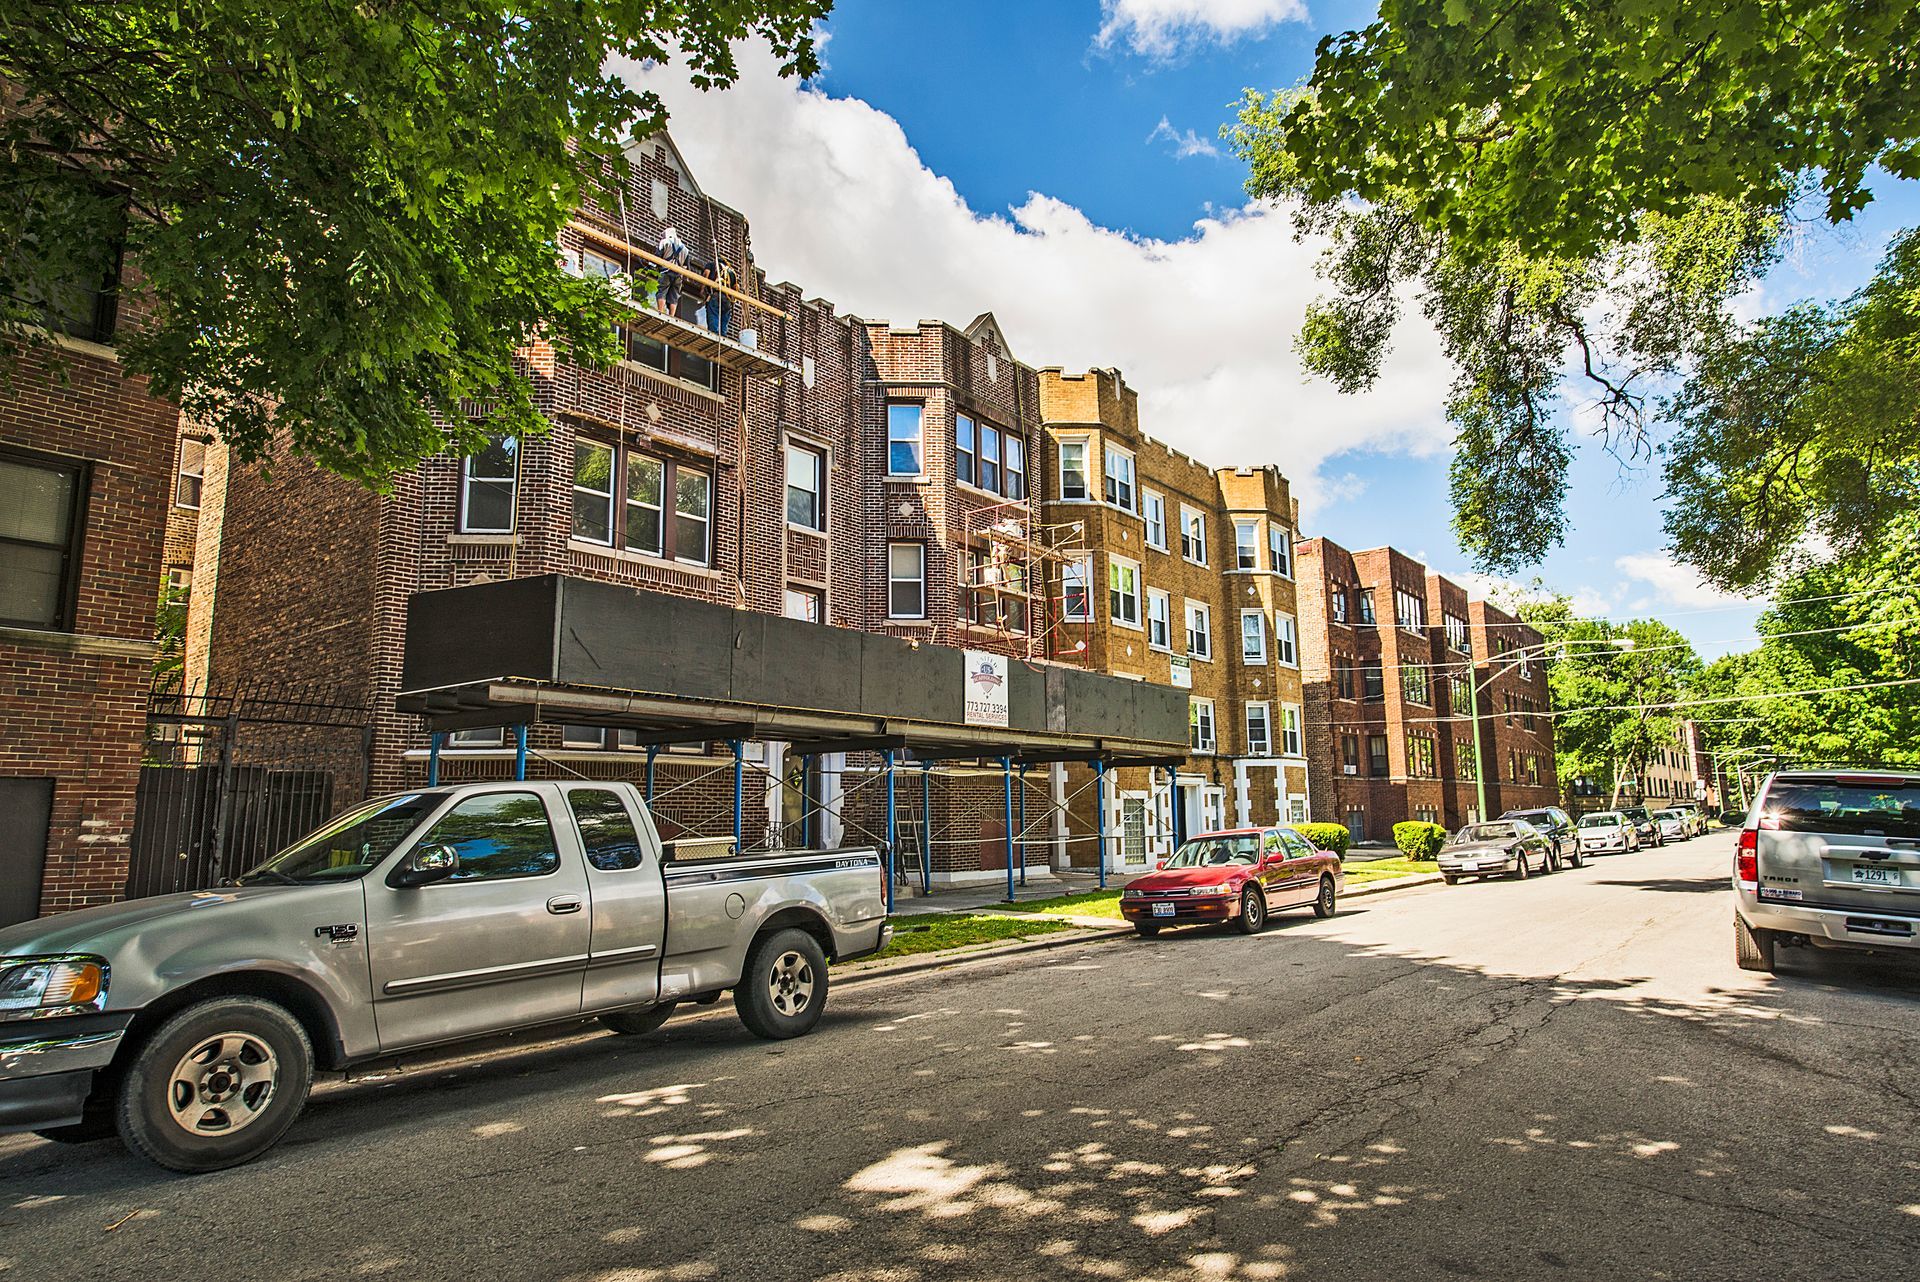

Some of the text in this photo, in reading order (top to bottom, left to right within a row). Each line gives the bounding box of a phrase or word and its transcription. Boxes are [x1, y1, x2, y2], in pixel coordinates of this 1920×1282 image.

[835, 858, 868, 868] DAYTONA
[1763, 875, 1799, 883] TAHOE
[1865, 870, 1888, 881] 1291
